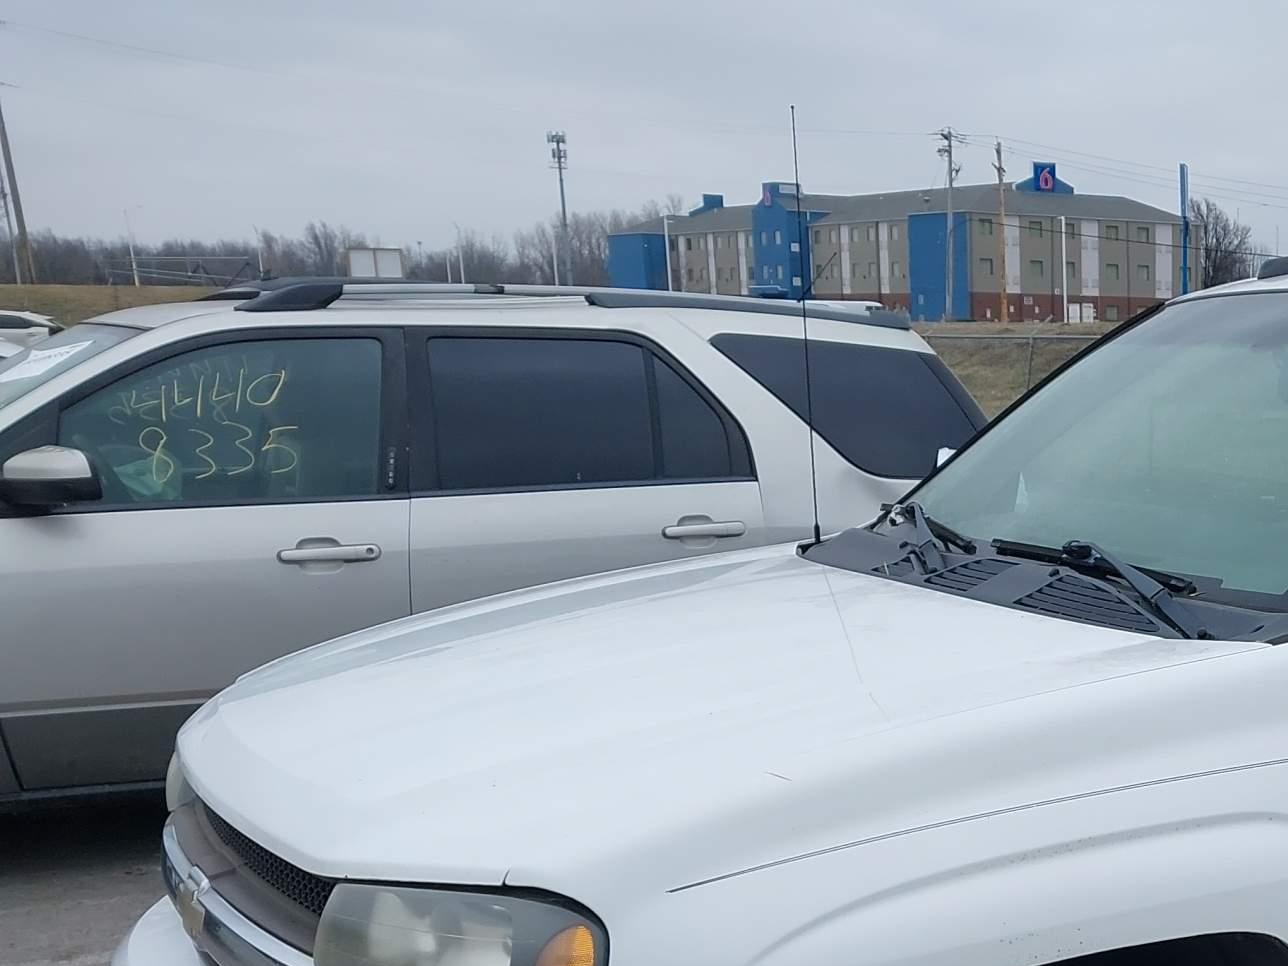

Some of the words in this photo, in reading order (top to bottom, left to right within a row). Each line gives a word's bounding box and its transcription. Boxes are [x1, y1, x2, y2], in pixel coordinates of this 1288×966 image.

[1039, 167, 1053, 190] 6
[129, 368, 286, 422] 4440
[138, 421, 299, 484] 8335
